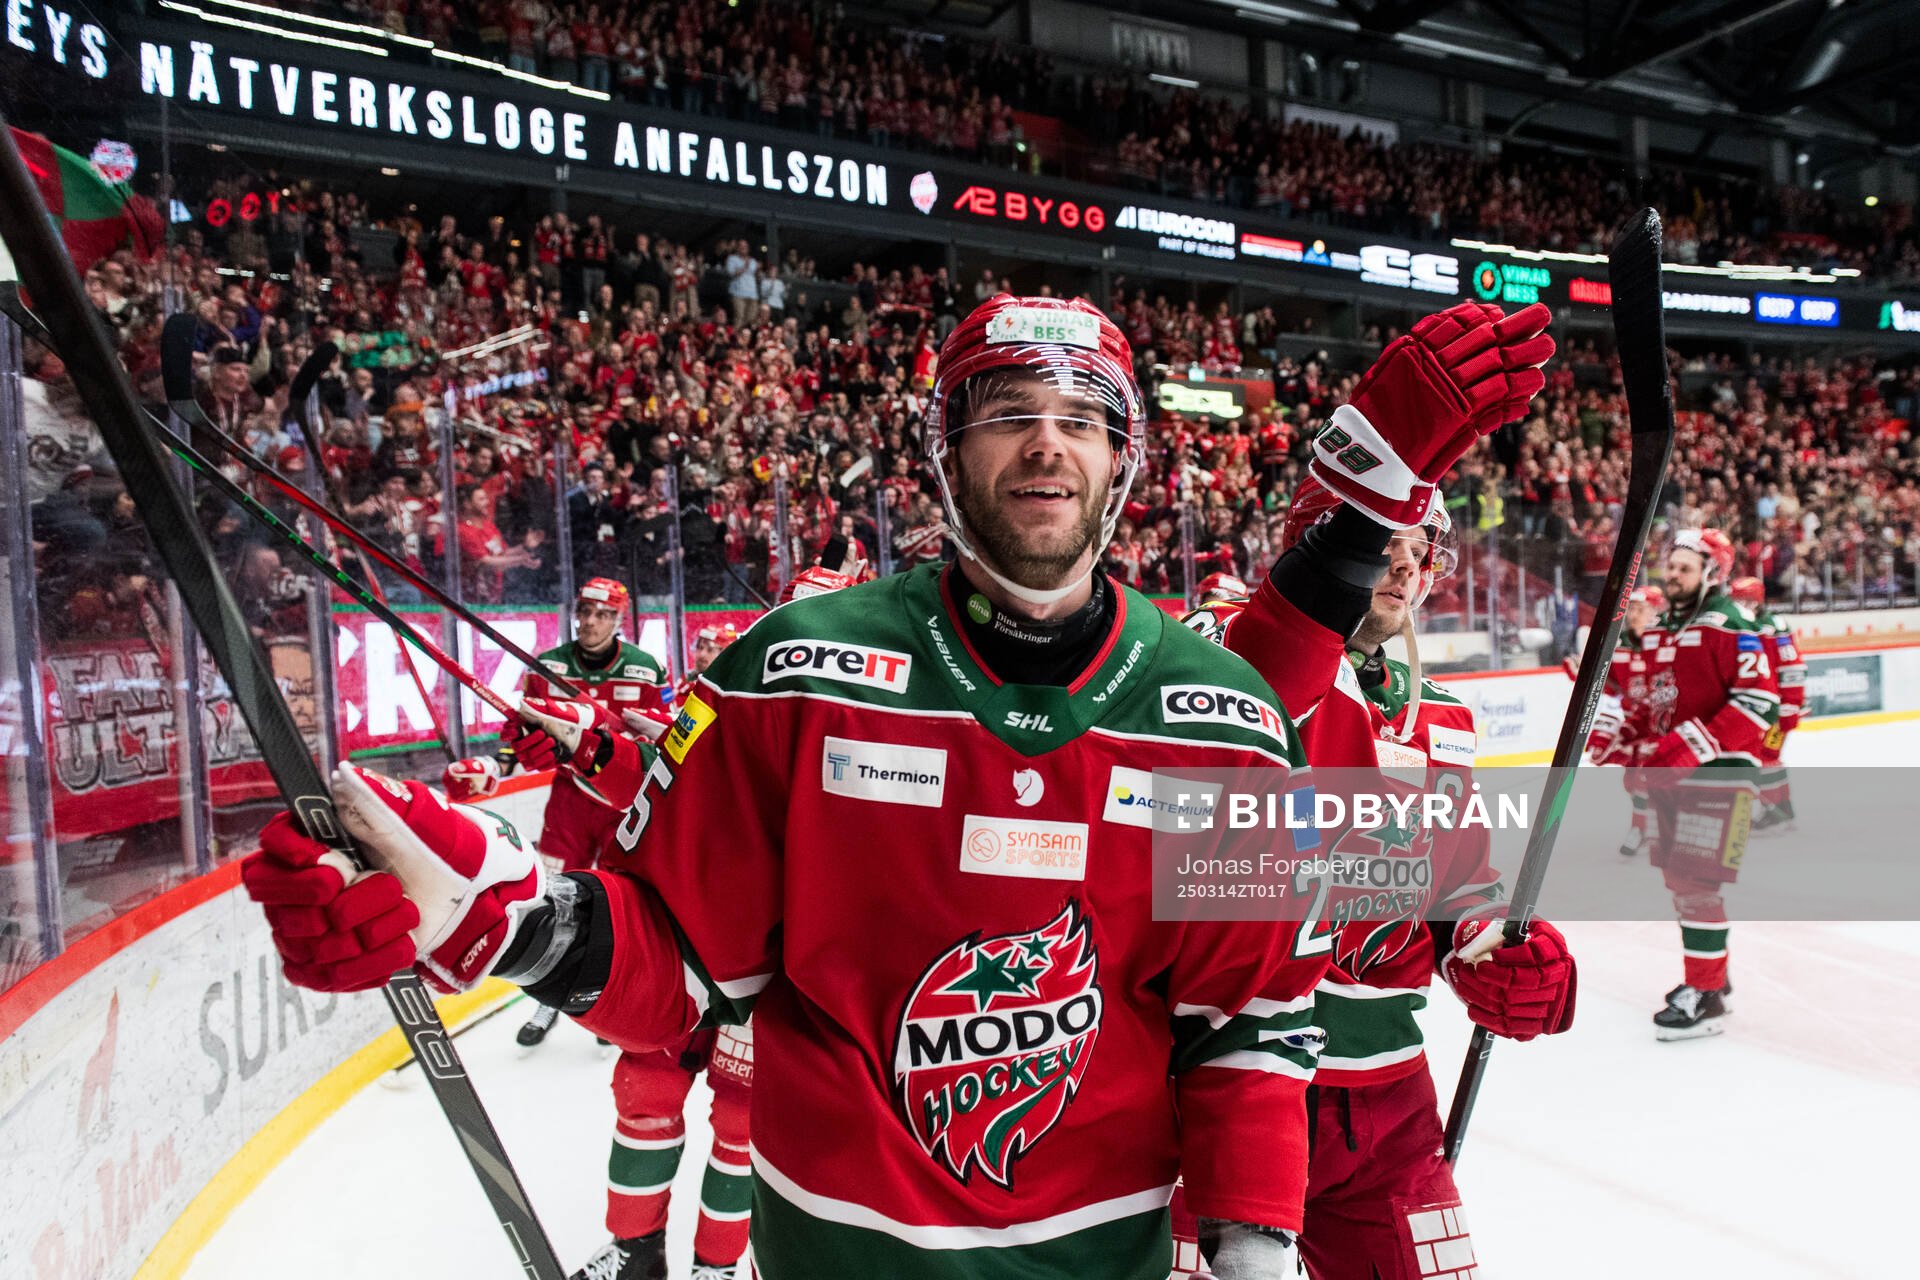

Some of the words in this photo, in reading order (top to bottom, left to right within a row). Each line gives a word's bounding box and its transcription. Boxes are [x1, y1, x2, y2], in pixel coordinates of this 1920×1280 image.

[6, 0, 109, 78] EYS
[139, 41, 588, 161] NÄTVERKSLOGE
[614, 121, 888, 206] ANFALLSZON
[1033, 325, 1077, 341] BESS
[969, 600, 990, 619] dina
[997, 611, 1018, 629] Dina
[994, 619, 1053, 644] Försäkringar
[766, 645, 907, 684] coreIT
[1737, 652, 1771, 679] 24
[1003, 711, 1054, 733] SHL
[1166, 690, 1282, 737] coreIT
[857, 764, 940, 786] Thermion
[1136, 796, 1214, 817] ACTEMIUM
[1007, 831, 1082, 851] SYNSAM
[1005, 850, 1081, 869] SPORTS
[1332, 854, 1428, 888] MODO
[906, 993, 1097, 1068] MODO
[922, 1037, 1084, 1140] HOCKEY
